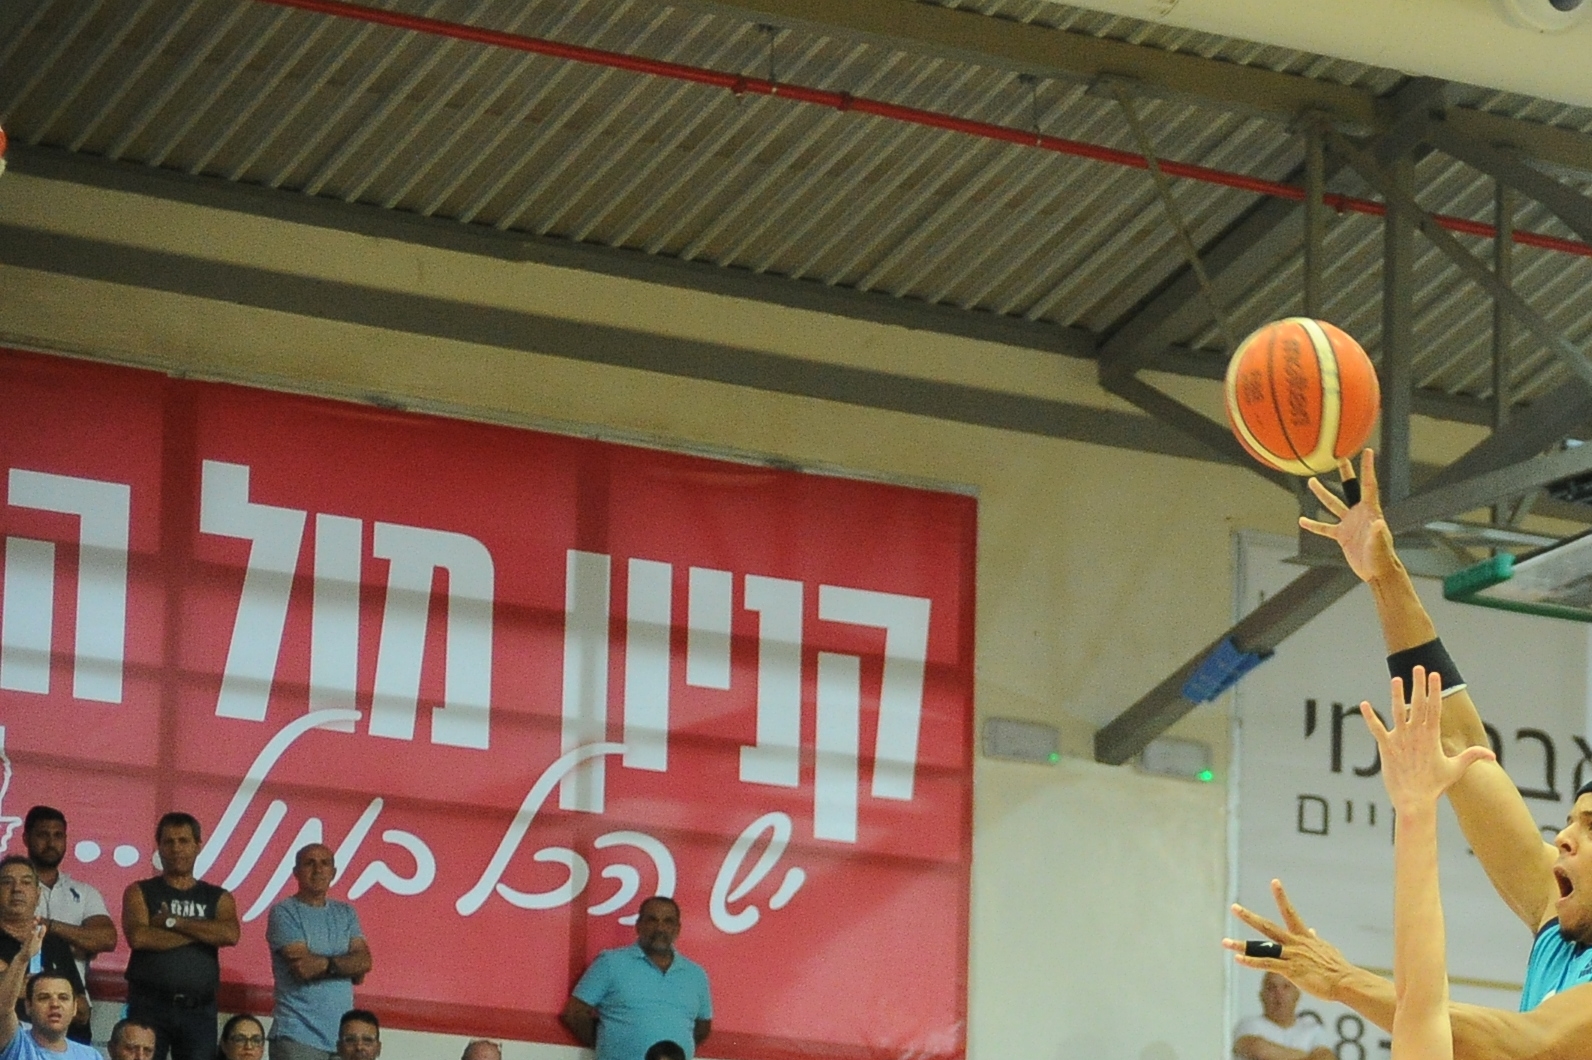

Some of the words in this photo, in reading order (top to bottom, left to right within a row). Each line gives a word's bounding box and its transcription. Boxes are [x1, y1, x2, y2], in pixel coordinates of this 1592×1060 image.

[0, 468, 131, 703] ה
[200, 459, 495, 750] מול
[560, 550, 931, 843] קניון
[456, 741, 676, 925] הכל
[709, 812, 806, 933] יש
